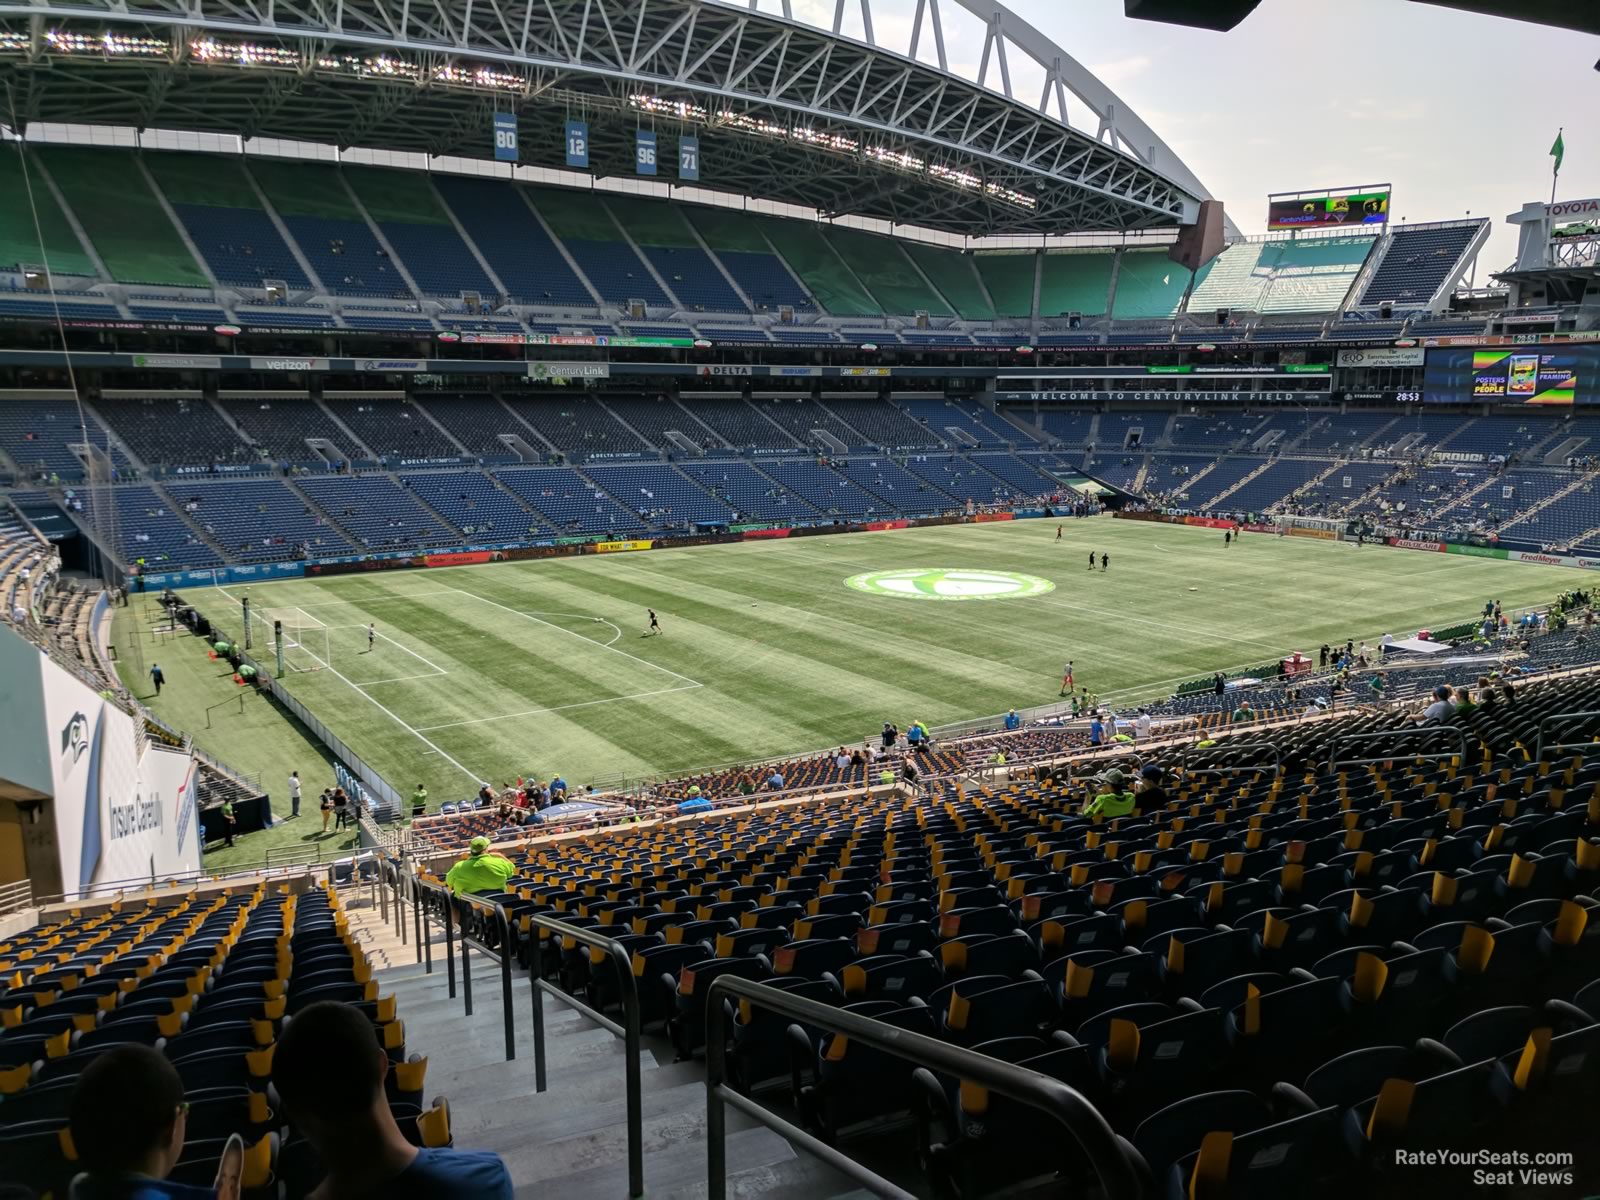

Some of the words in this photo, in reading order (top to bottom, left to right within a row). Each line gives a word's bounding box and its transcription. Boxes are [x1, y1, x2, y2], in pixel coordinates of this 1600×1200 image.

[496, 131, 516, 149] 80
[569, 139, 585, 156] 12
[638, 148, 655, 164] 96
[682, 153, 697, 170] 71
[1545, 201, 1599, 216] TOYOTA
[1450, 337, 1477, 345] SOUNDERS
[1478, 336, 1487, 344] FC
[1499, 336, 1504, 344] 0
[1516, 334, 1536, 343] 28:53
[1549, 334, 1554, 342] 0
[1568, 332, 1597, 341] SPORTING
[1367, 353, 1400, 361] Entertainment
[1401, 353, 1419, 361] Capital
[266, 360, 311, 371] verizon
[549, 365, 604, 377] CenturyLink
[713, 366, 748, 375] DELTA
[1475, 376, 1506, 384] POSTERS
[1474, 385, 1505, 394] PEOPLE
[1031, 393, 1098, 401] WELCOME
[1108, 393, 1124, 401] TO
[1134, 392, 1239, 401] CENTURYLINK
[1250, 392, 1294, 401] FIELD
[1396, 392, 1420, 401] 28:53
[600, 544, 609, 552] FOR
[609, 543, 622, 551] WHAT
[1398, 539, 1439, 551] ADVOCARE
[108, 796, 136, 841] Insure
